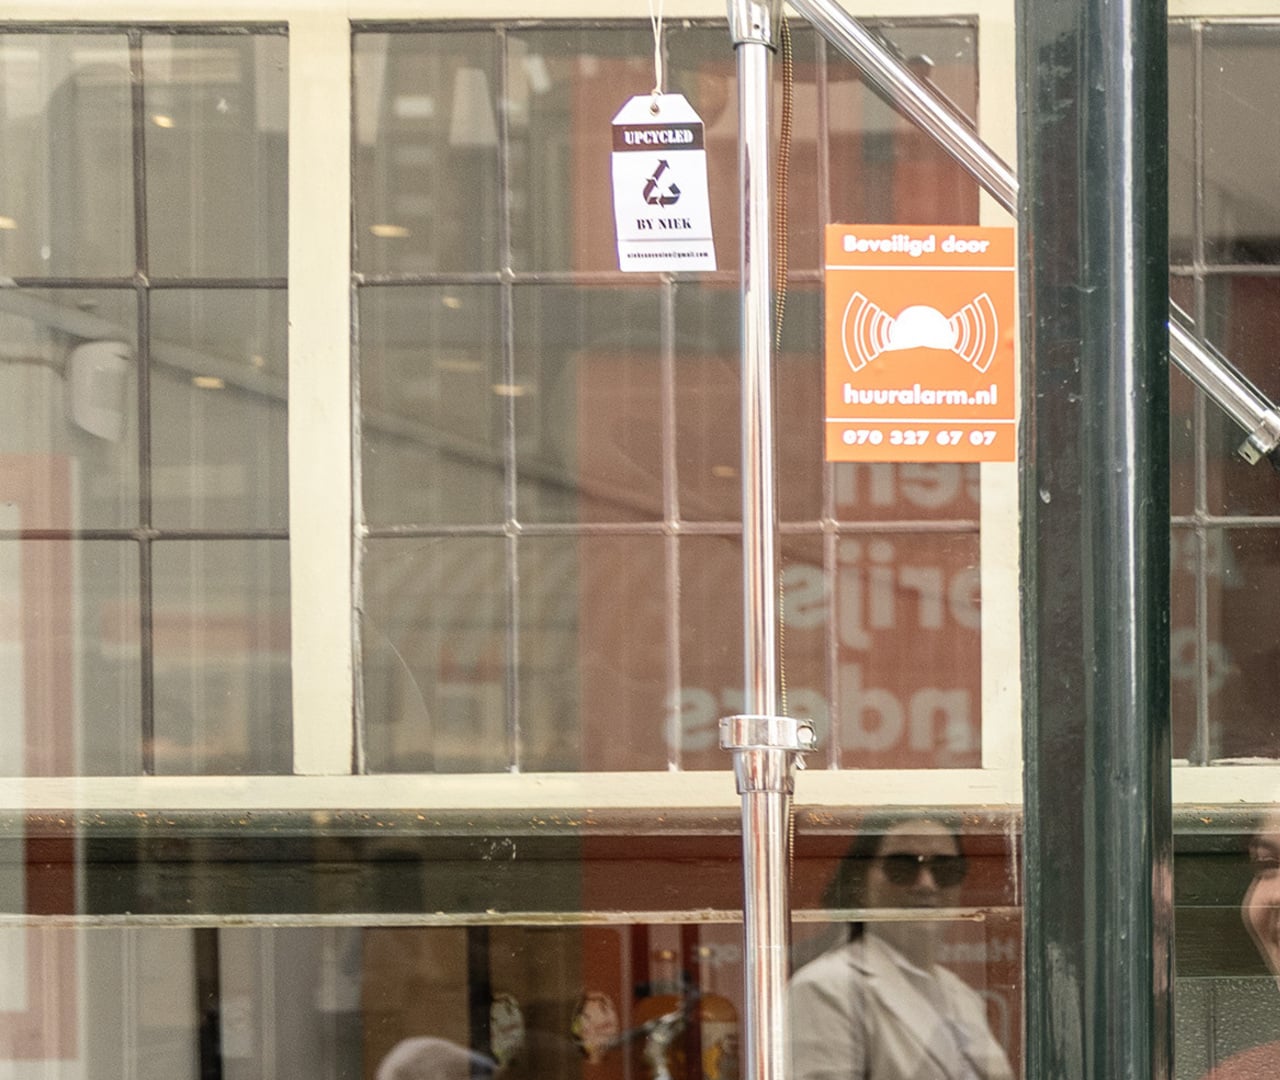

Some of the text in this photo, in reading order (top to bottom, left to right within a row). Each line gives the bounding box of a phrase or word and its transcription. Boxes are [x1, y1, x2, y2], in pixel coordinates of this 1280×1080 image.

[624, 129, 694, 145] UPCYCLED
[636, 217, 692, 230] BY NIEK
[843, 234, 989, 257] Beveiligd door
[844, 383, 997, 405] huuralarm.nl
[843, 429, 996, 445] 070 327 67 07
